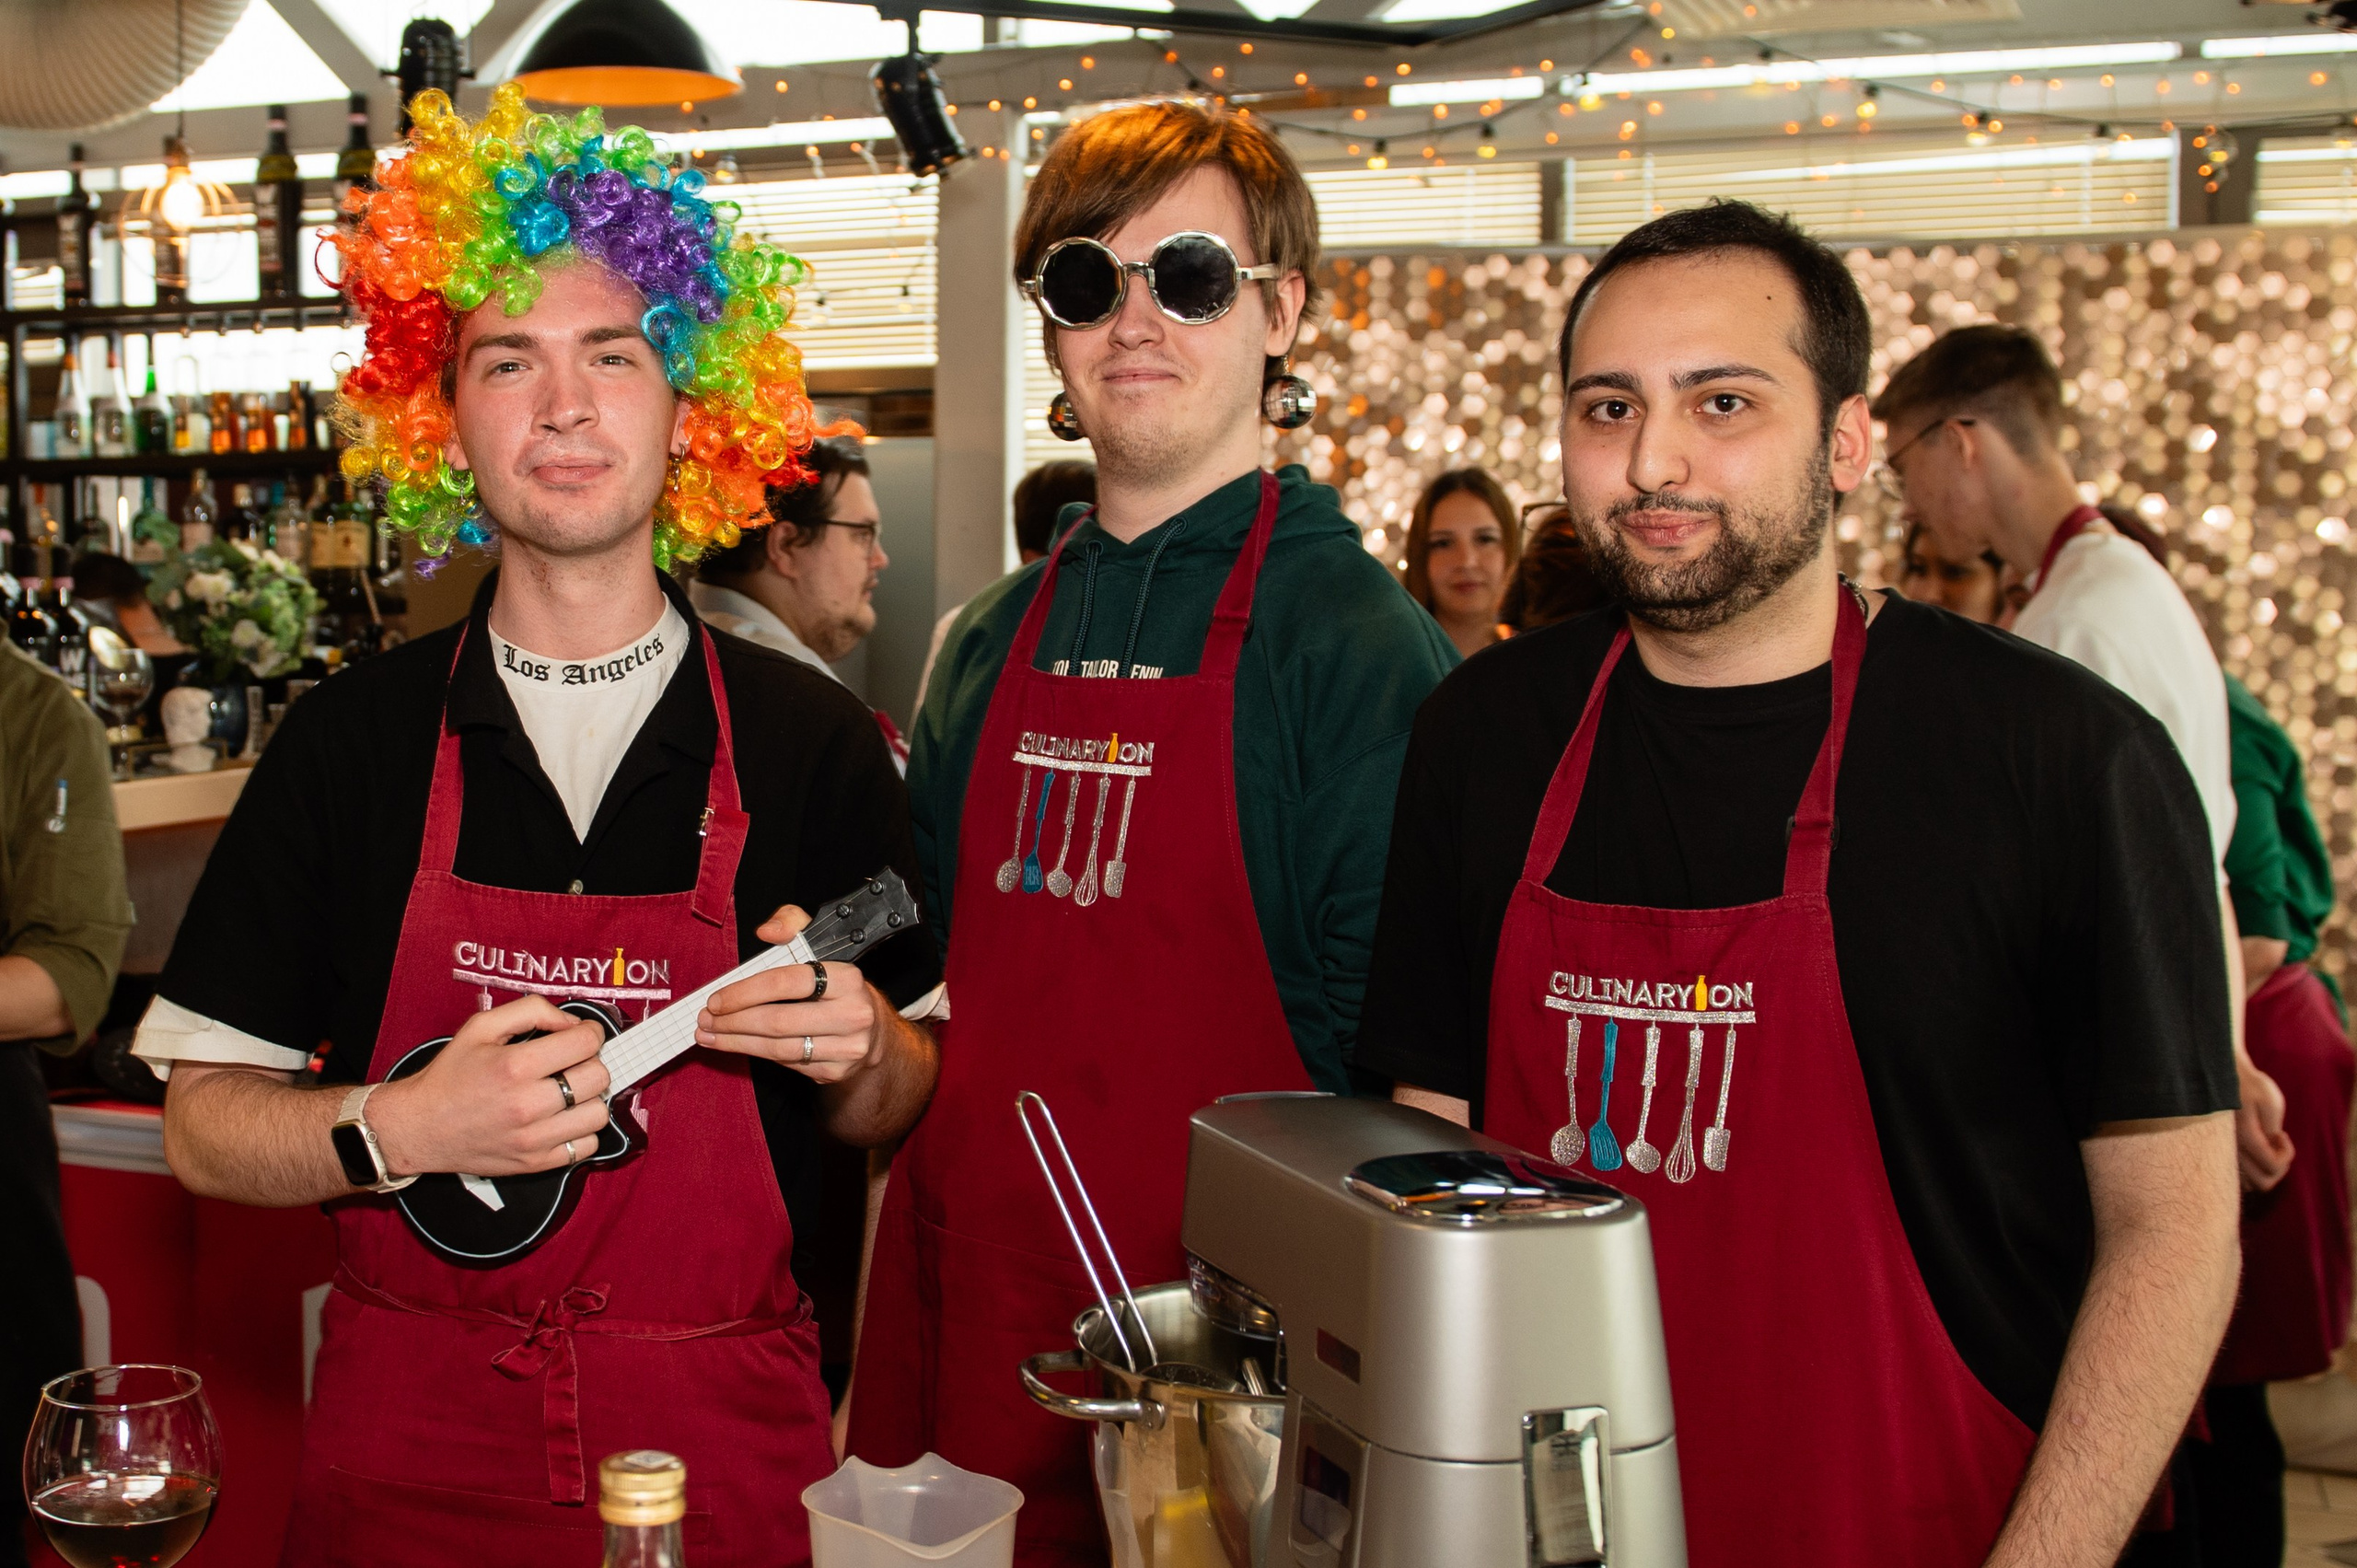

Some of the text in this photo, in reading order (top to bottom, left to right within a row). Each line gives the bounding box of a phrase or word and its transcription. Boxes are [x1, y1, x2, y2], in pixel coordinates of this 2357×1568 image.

[503, 633, 665, 685] Los Angeles
[1081, 659, 1119, 679] TAILOR
